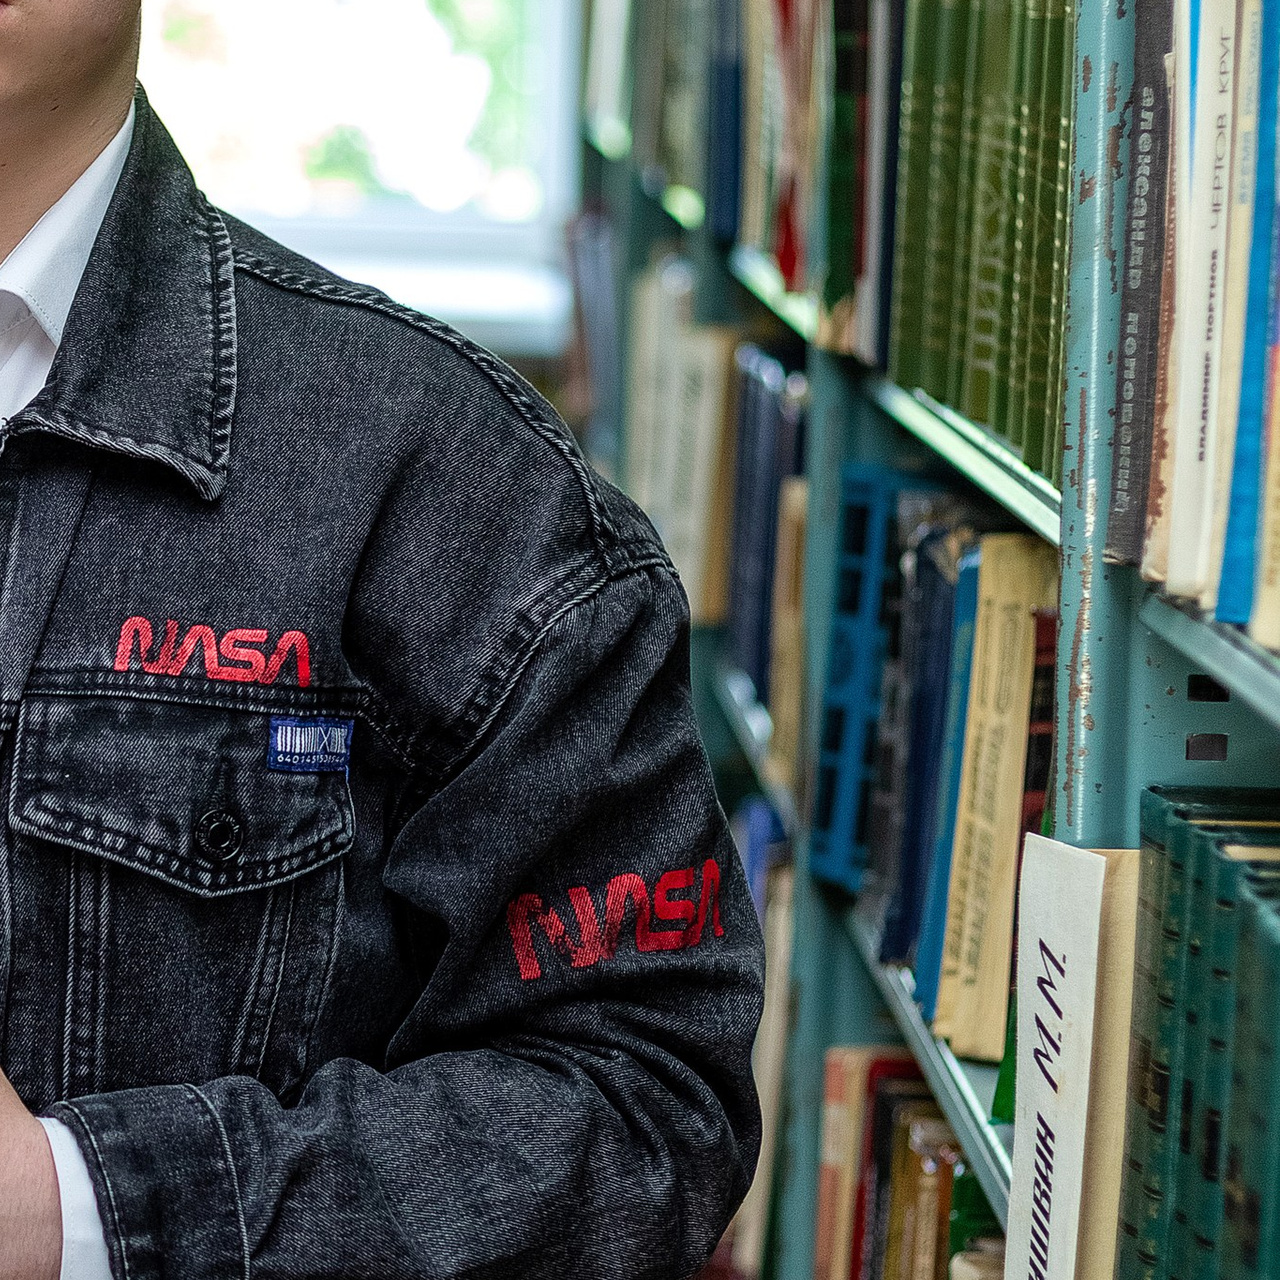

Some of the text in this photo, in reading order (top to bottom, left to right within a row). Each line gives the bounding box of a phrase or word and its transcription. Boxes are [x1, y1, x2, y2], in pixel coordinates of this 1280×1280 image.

[1114, 87, 1155, 513] александр поповский
[1198, 25, 1231, 463] ВЛАДИМИР ПОРТНОВ ЧЕРТОВ КРУГ
[115, 616, 311, 688] NASA
[508, 859, 725, 981] NASA
